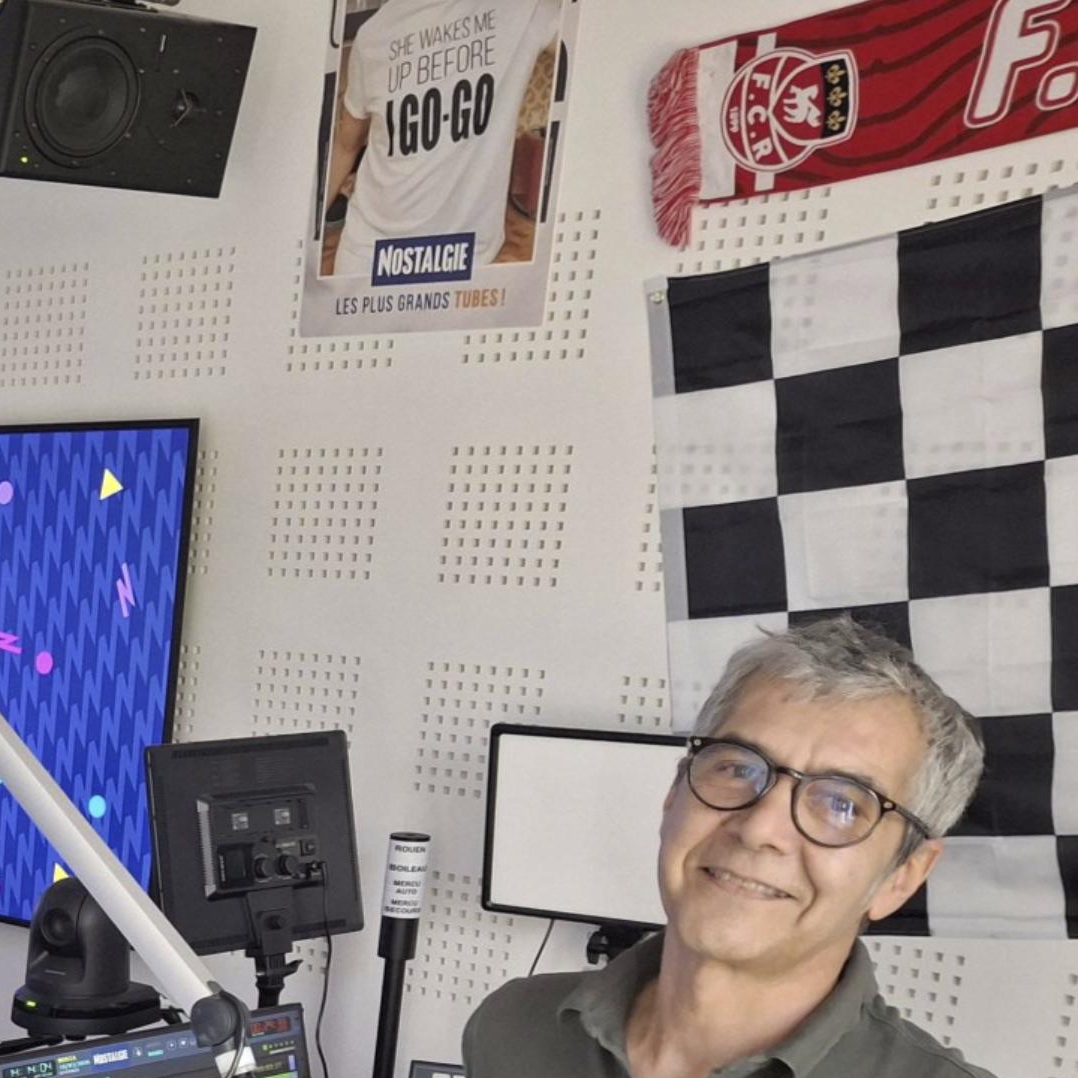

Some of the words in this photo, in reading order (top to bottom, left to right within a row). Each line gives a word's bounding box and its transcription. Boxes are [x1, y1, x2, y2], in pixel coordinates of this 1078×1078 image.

[388, 39, 415, 61] SHE
[419, 16, 471, 48] WAKES
[474, 9, 497, 32] ME
[388, 61, 412, 93] UP
[417, 36, 496, 85] BEFORE
[377, 242, 469, 277] NOSTALGIE
[335, 297, 358, 315] LES
[361, 294, 393, 313] PLUS
[397, 291, 450, 312] GRANDS
[395, 845, 426, 853] ROUEN
